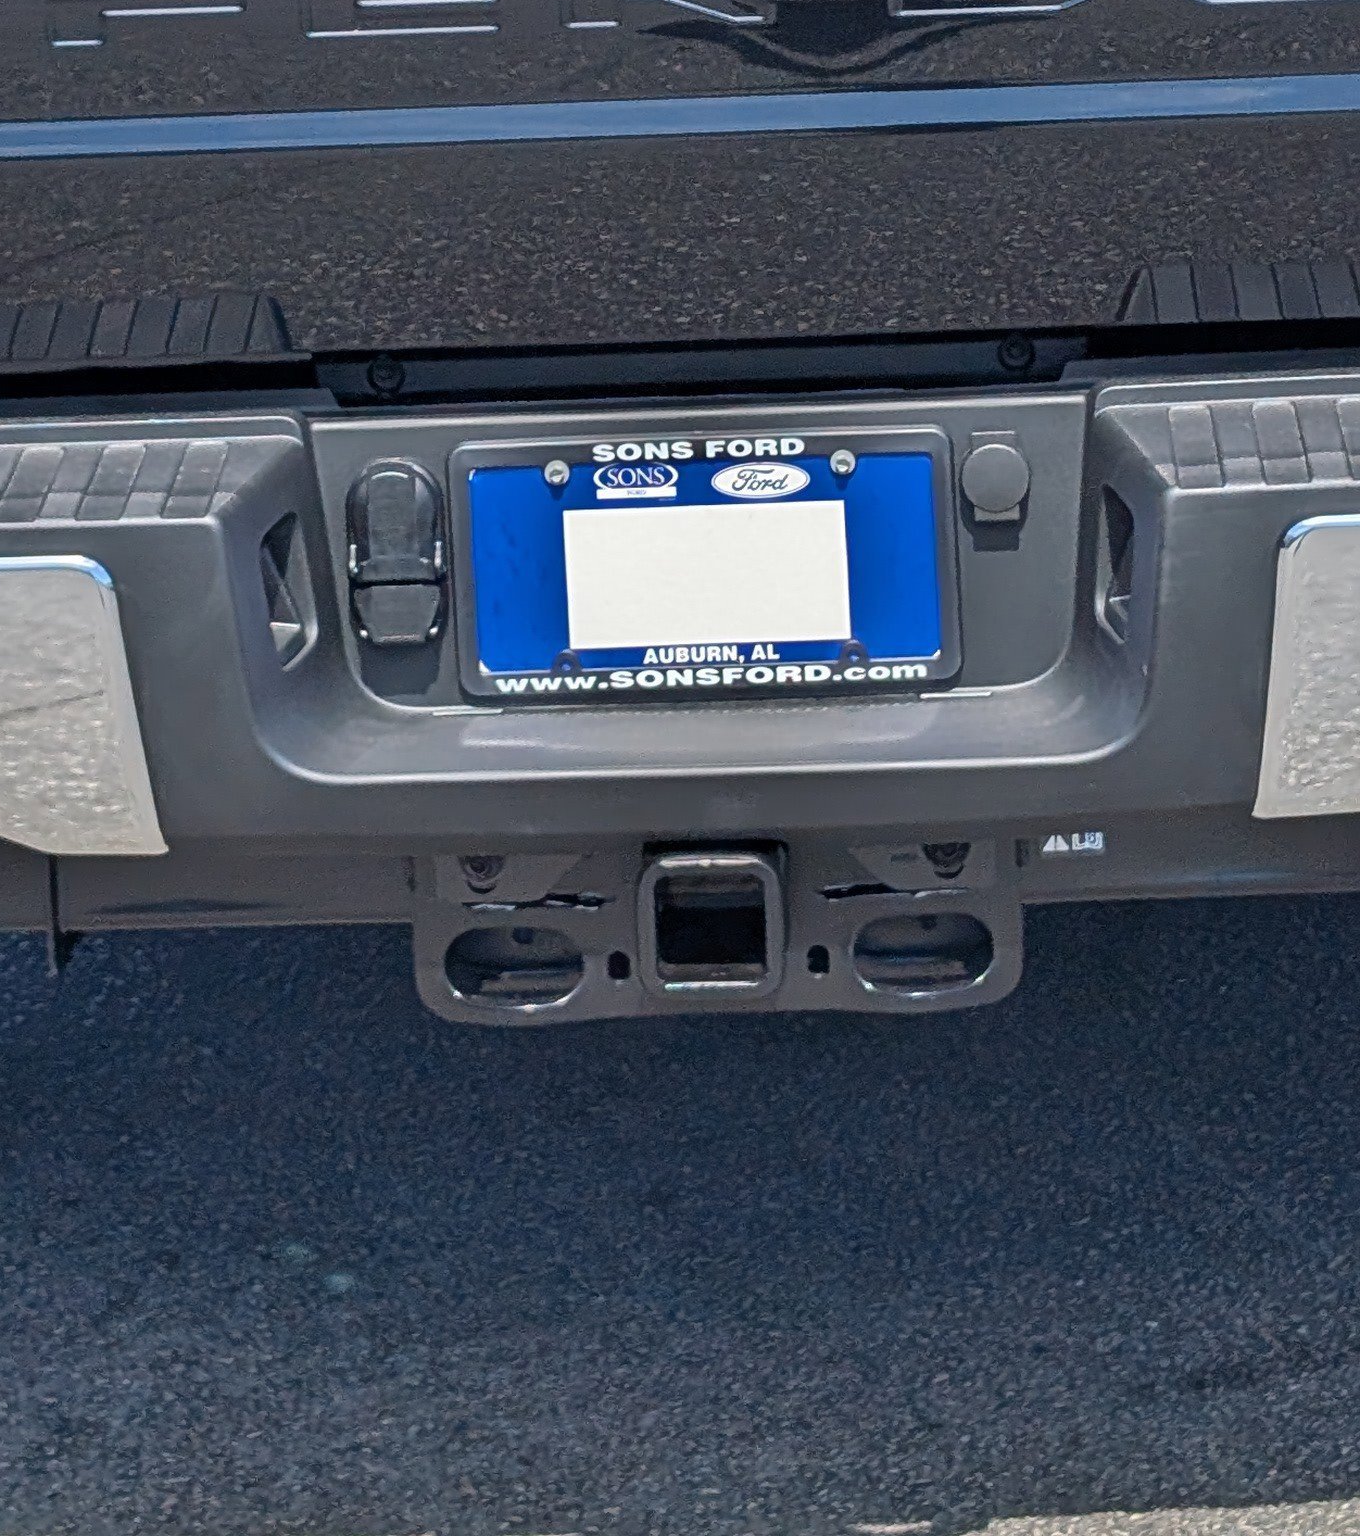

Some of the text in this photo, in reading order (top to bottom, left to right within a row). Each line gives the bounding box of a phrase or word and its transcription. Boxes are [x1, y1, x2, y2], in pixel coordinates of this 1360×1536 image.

[592, 438, 805, 462] SONS FORD
[607, 466, 665, 488] SONS
[732, 468, 789, 493] Ford
[643, 644, 780, 665] AUBURN, AL
[496, 663, 928, 694] www.SONSFORD.com
